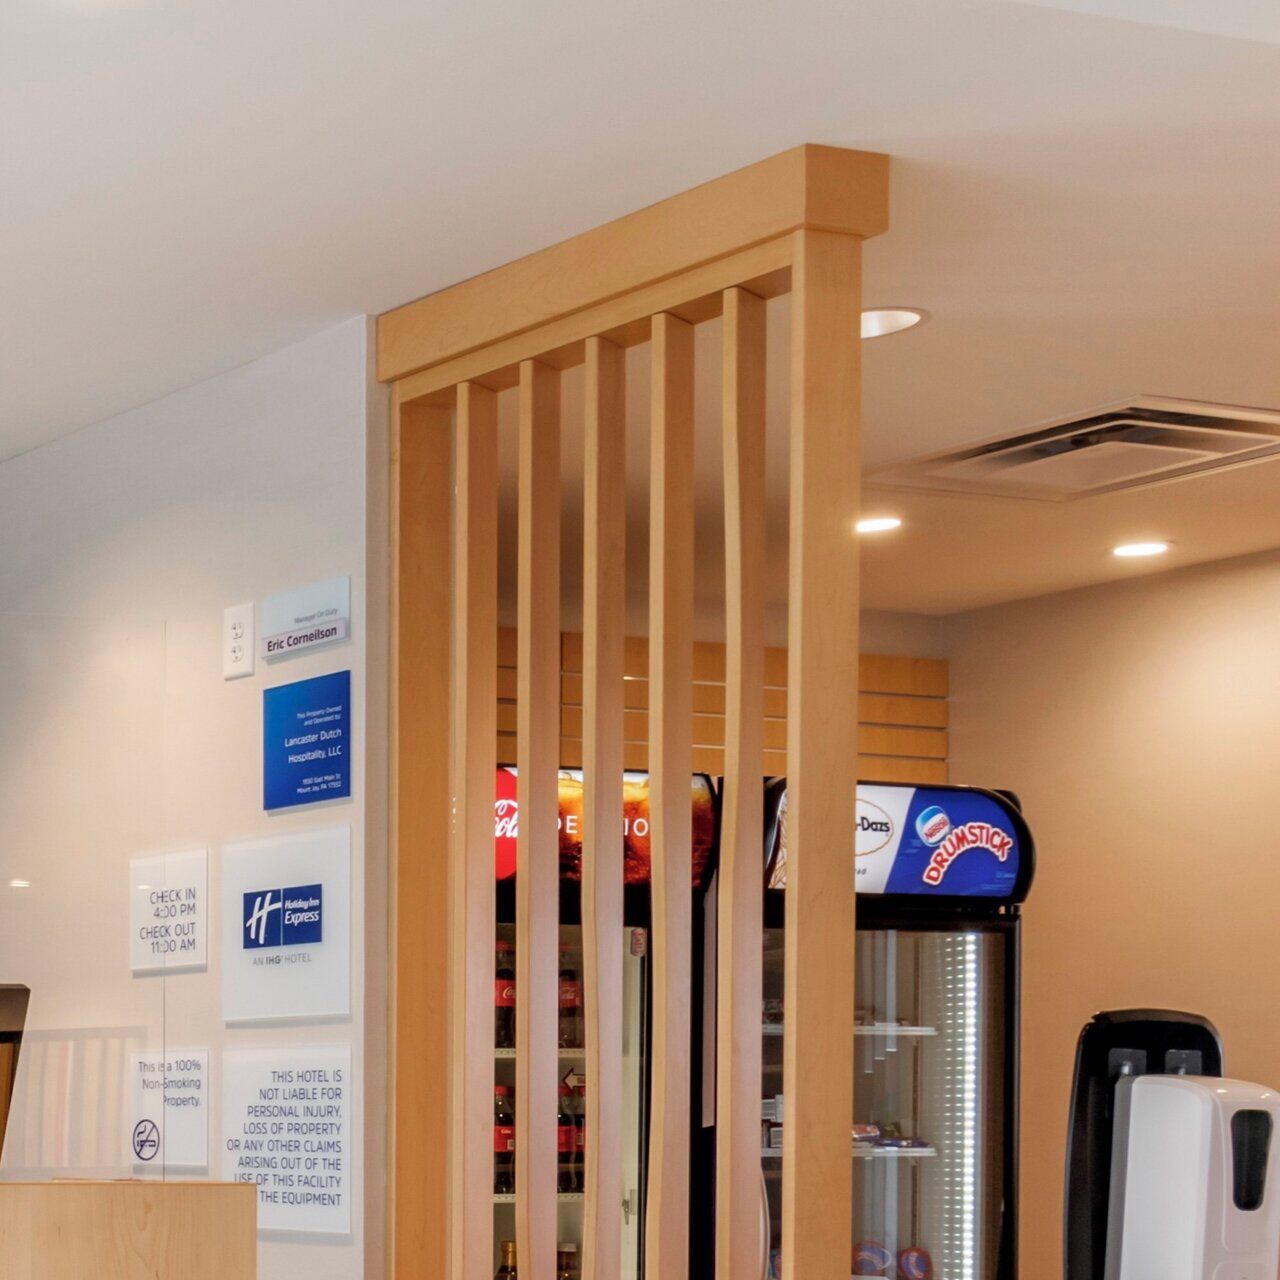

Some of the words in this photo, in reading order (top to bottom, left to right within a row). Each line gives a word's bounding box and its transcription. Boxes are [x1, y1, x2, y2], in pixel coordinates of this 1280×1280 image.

[267, 639, 285, 652] Eric
[285, 734, 318, 747] Lancaster
[320, 729, 342, 740] Dutch
[288, 749, 327, 764] Hospitality,
[328, 745, 342, 756] LLC
[924, 823, 1013, 884] DRUMSTICK
[150, 889, 181, 904] CHECK
[185, 887, 196, 900] IN
[180, 903, 196, 916] PM
[285, 898, 309, 910] Holiday
[308, 897, 320, 906] Inn
[285, 911, 319, 926] Express
[140, 925, 171, 940] CHECK
[175, 922, 196, 936] OUT
[180, 938, 196, 951] AM
[253, 957, 264, 965] AN
[266, 955, 281, 965] IHG
[284, 952, 312, 963] HOTEL
[138, 1061, 155, 1072] This
[167, 1063, 172, 1071] a
[175, 1059, 202, 1071] 100%
[272, 1070, 294, 1083] THIS
[297, 1070, 329, 1082] HOTEL
[333, 1069, 342, 1082] IS
[259, 1088, 279, 1100] NOT
[283, 1087, 318, 1100] LIABLE
[321, 1087, 342, 1100] FOR
[247, 1105, 299, 1117] PERSONAL
[303, 1105, 342, 1118] INJURY,
[243, 1122, 268, 1135] LOSS
[271, 1123, 284, 1134] OF
[287, 1123, 342, 1135] PROPERTY
[226, 1139, 241, 1151] OR
[243, 1139, 264, 1151] ANY
[267, 1140, 300, 1152] OTHER
[303, 1140, 342, 1153] CLAIMS
[238, 1157, 278, 1169] ARISING
[281, 1157, 301, 1169] OUT
[304, 1158, 318, 1170] OF
[322, 1158, 342, 1171] THE
[256, 1173, 269, 1185] OF
[272, 1174, 294, 1187] THIS
[297, 1175, 342, 1188] FACILITY
[260, 1191, 278, 1203] THE
[282, 1191, 342, 1206] EQUIPMENT
